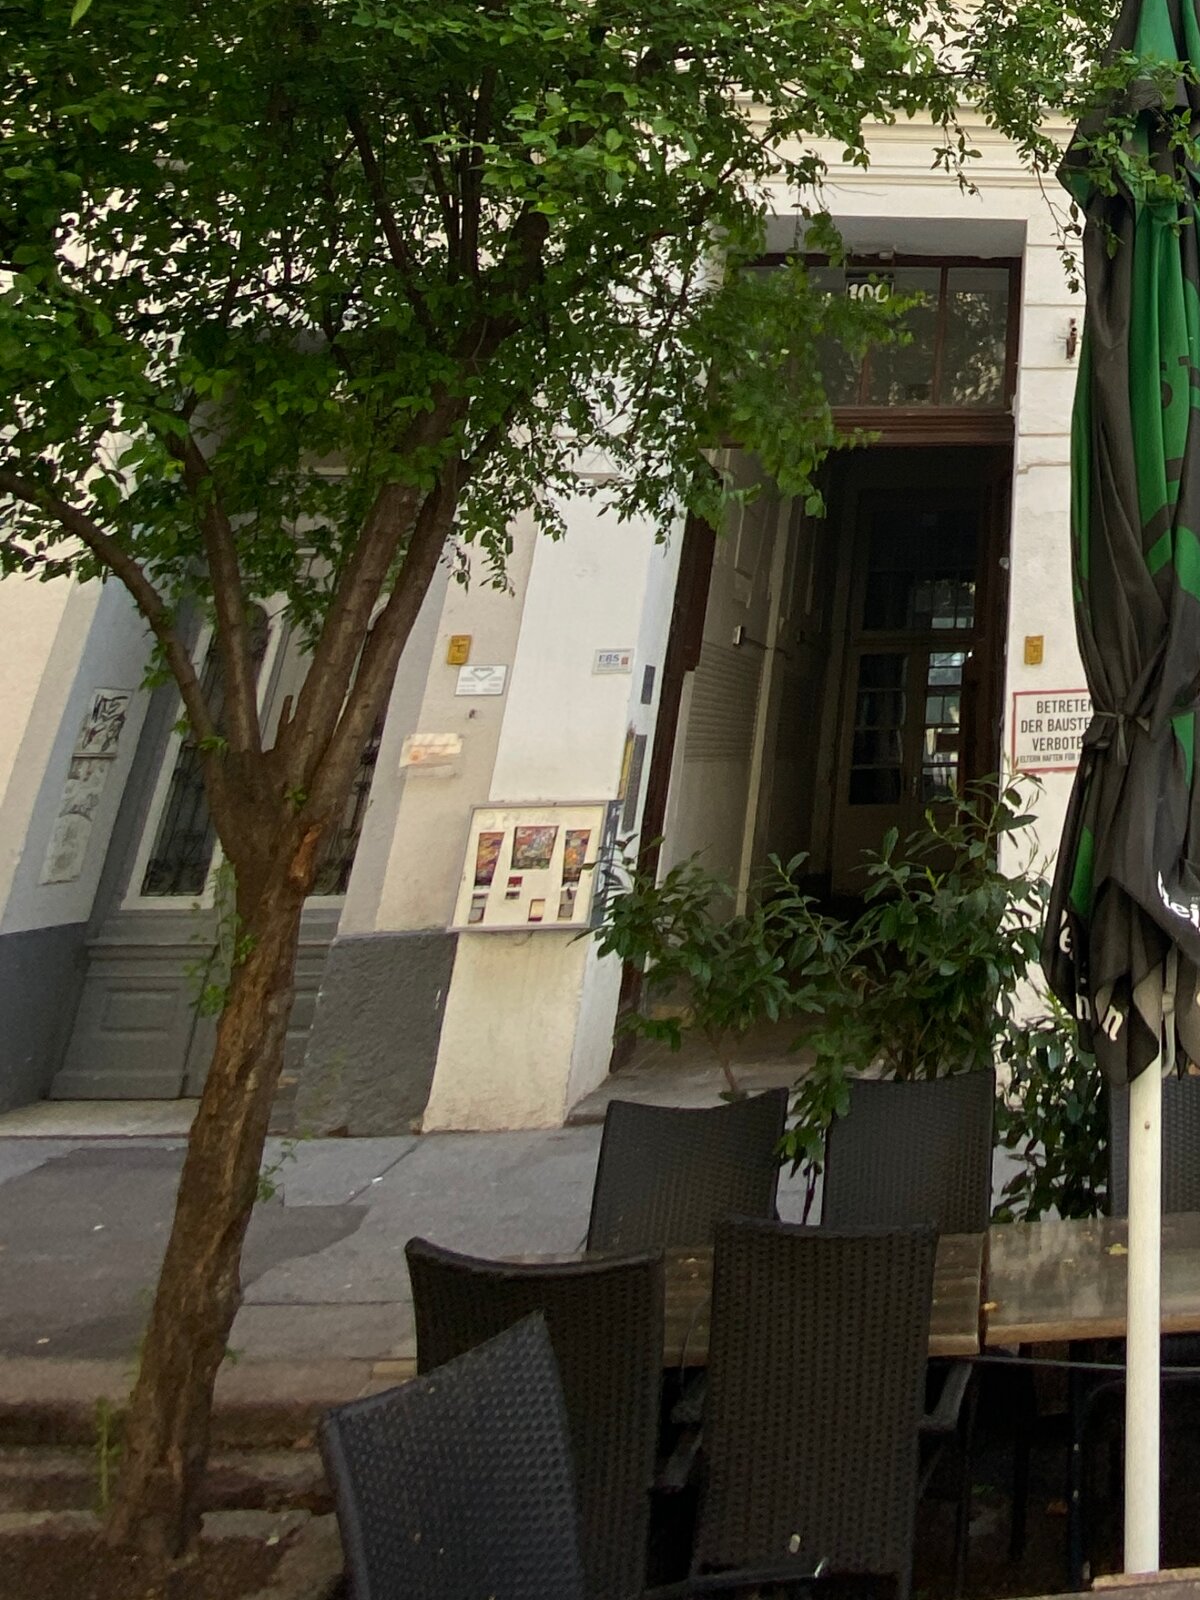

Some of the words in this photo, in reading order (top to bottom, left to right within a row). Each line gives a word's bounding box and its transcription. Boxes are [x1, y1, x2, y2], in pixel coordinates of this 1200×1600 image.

[1021, 719, 1043, 733] DER
[1047, 717, 1090, 732] BAUSTE
[1032, 736, 1083, 751] VERBOTE
